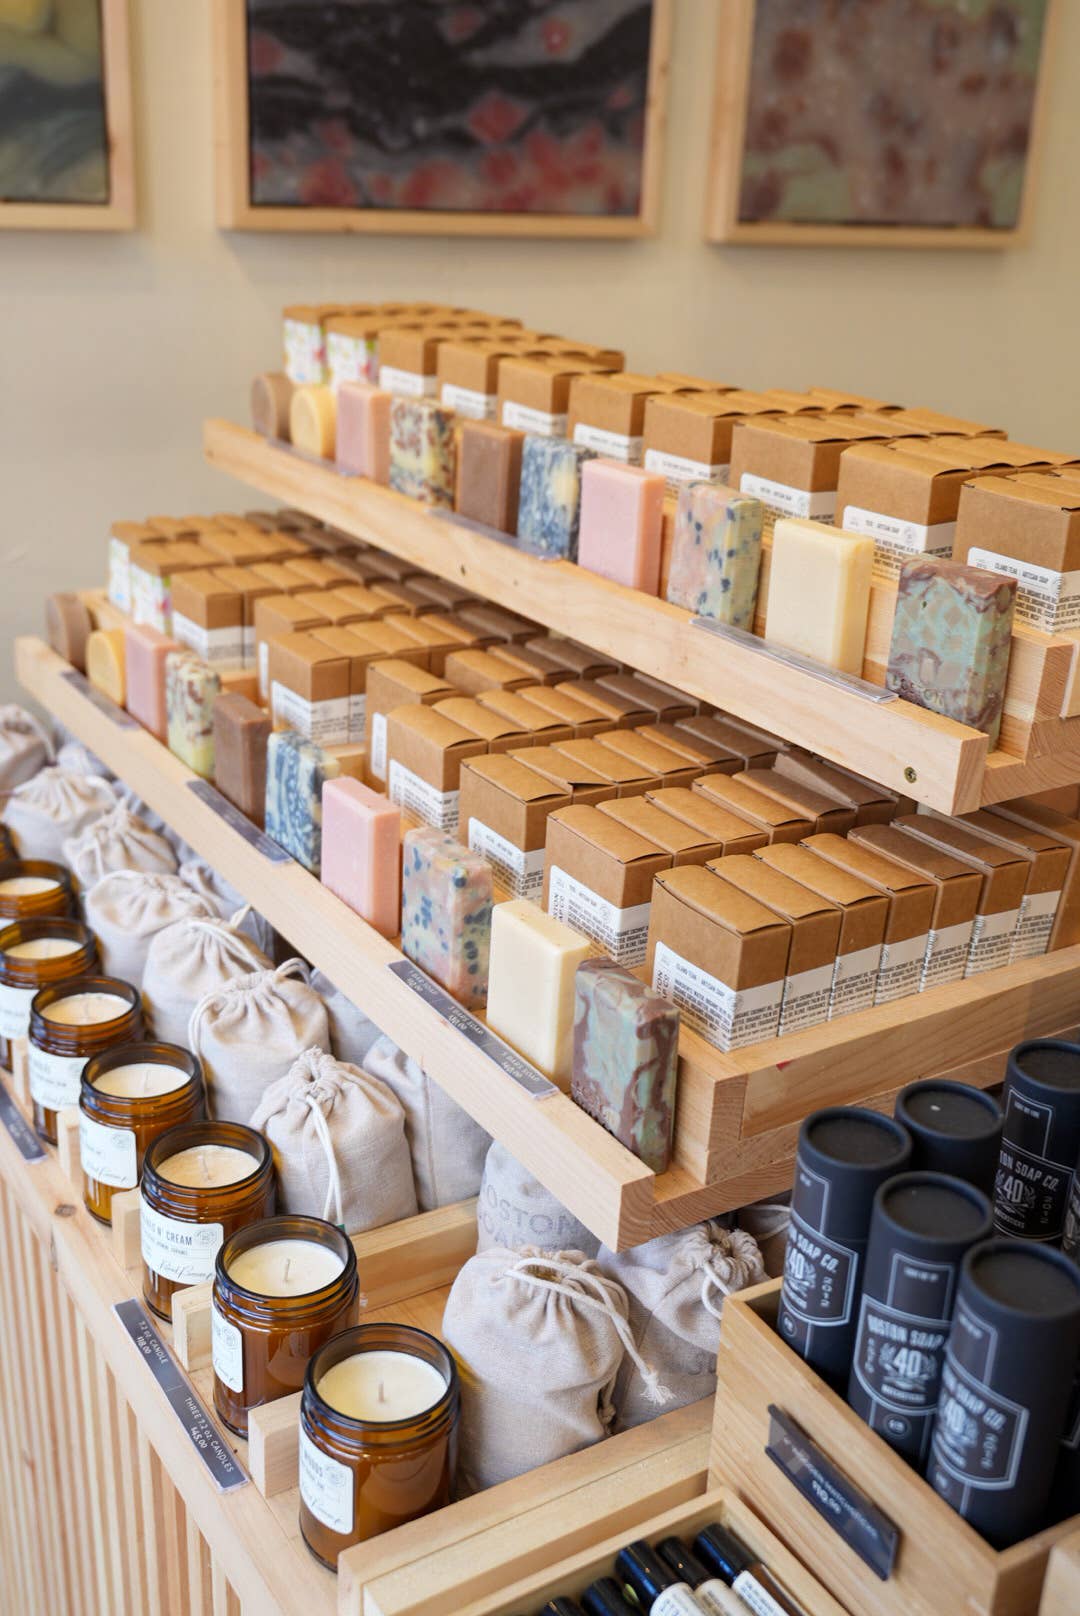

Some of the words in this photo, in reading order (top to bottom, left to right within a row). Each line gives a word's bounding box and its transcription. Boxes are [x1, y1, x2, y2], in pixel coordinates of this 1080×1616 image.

[1014, 1160, 1042, 1181] SOAP
[1003, 1175, 1024, 1203] 40
[166, 1231, 193, 1247] CREAM
[797, 1233, 821, 1260] SOAP
[150, 1339, 169, 1364] CANDLE
[892, 1348, 922, 1377] 40
[185, 1397, 202, 1419] THREE
[210, 1440, 234, 1473] CANDLES
